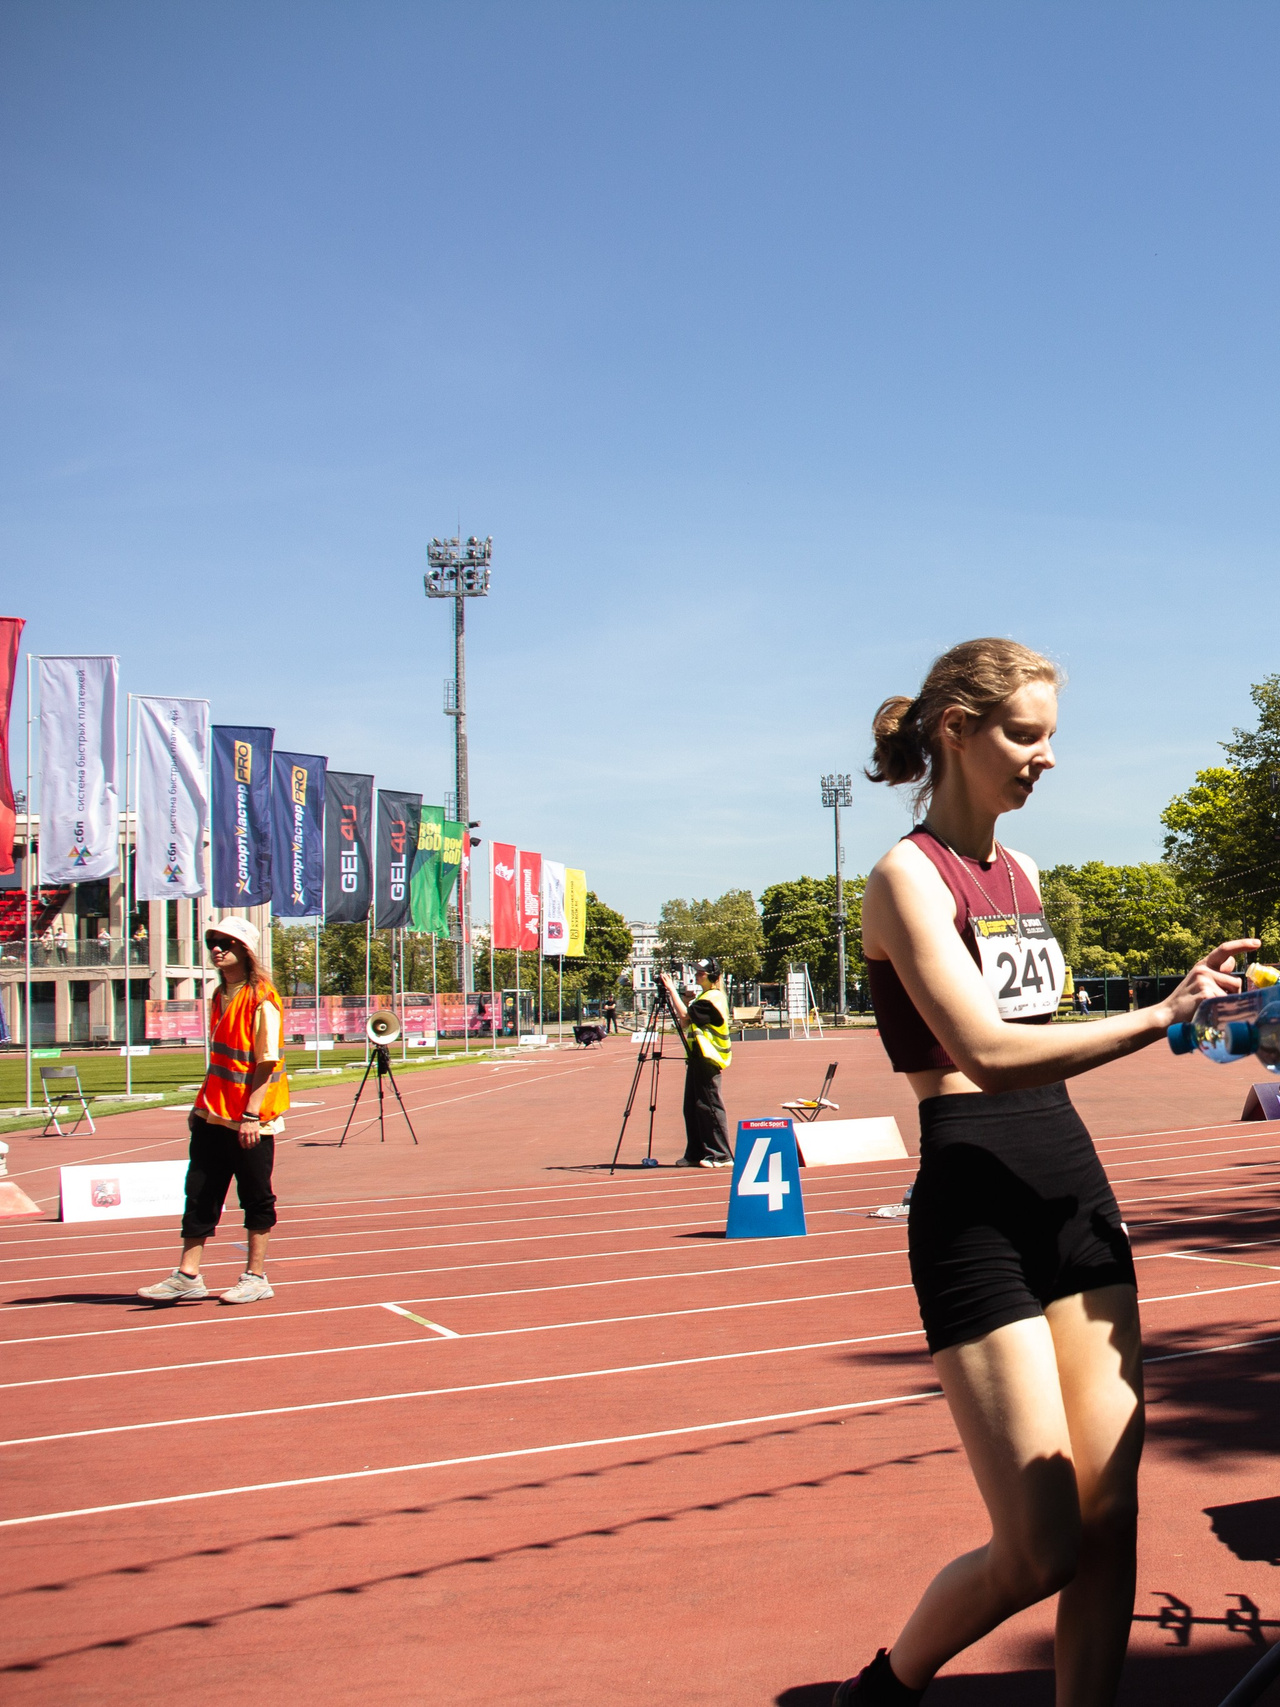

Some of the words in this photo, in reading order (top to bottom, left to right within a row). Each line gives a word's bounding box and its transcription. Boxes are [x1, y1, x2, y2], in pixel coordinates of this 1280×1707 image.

[76, 669, 86, 720] платежей
[75, 722, 88, 768] быстрых
[237, 744, 249, 782] PRO
[77, 769, 86, 812] система
[294, 769, 305, 803] PRO
[996, 946, 1056, 1000] 241
[737, 1136, 791, 1212] 4
